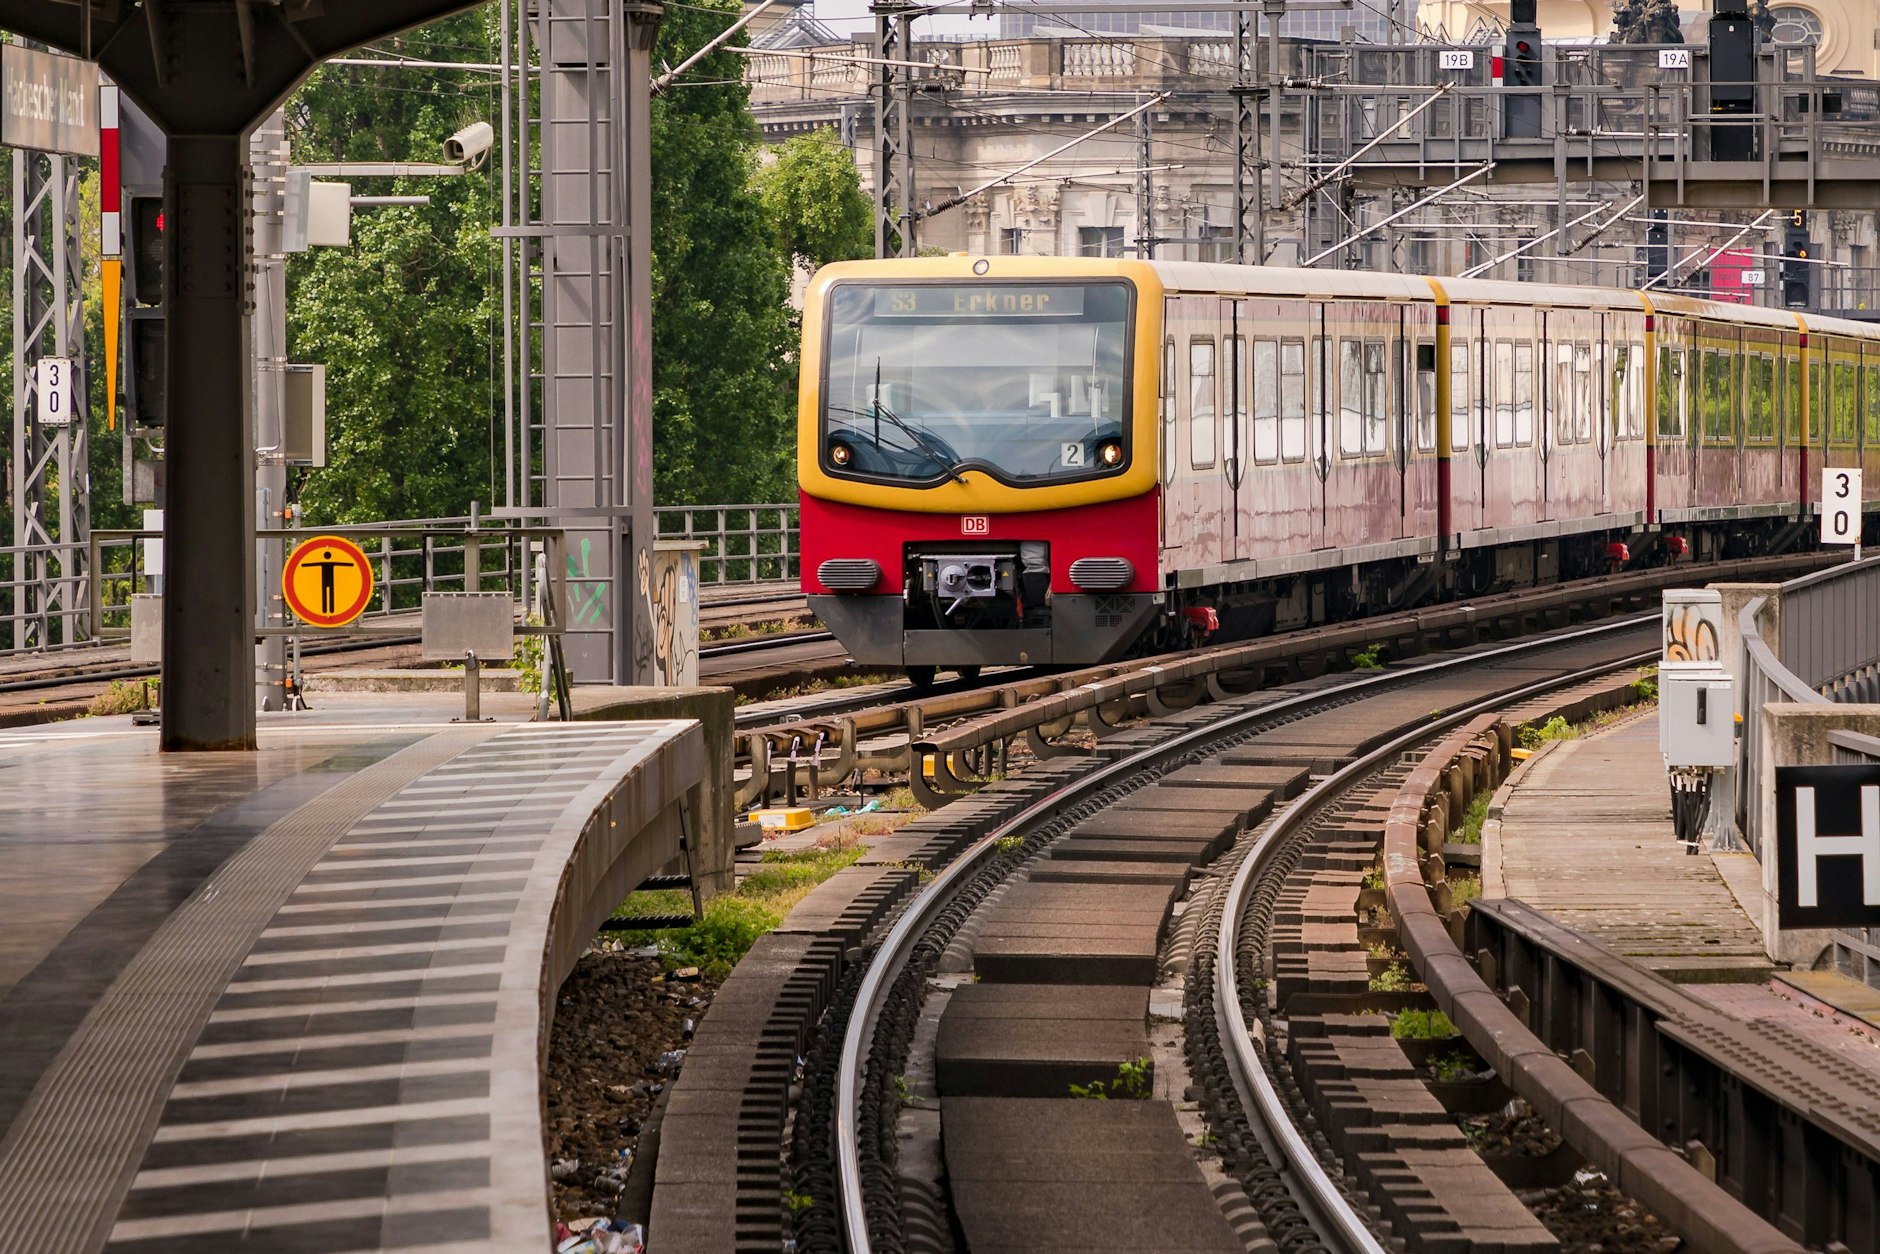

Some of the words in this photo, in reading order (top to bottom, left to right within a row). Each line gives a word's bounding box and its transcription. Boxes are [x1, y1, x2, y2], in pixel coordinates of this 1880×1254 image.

[1445, 54, 1468, 66] 19B
[1664, 53, 1688, 65] 19A
[1794, 209, 1802, 226] 5
[1748, 273, 1759, 282] 87
[891, 290, 916, 312] S3
[1067, 444, 1078, 464] 2
[965, 518, 986, 531] DB
[1796, 785, 1880, 907] H
